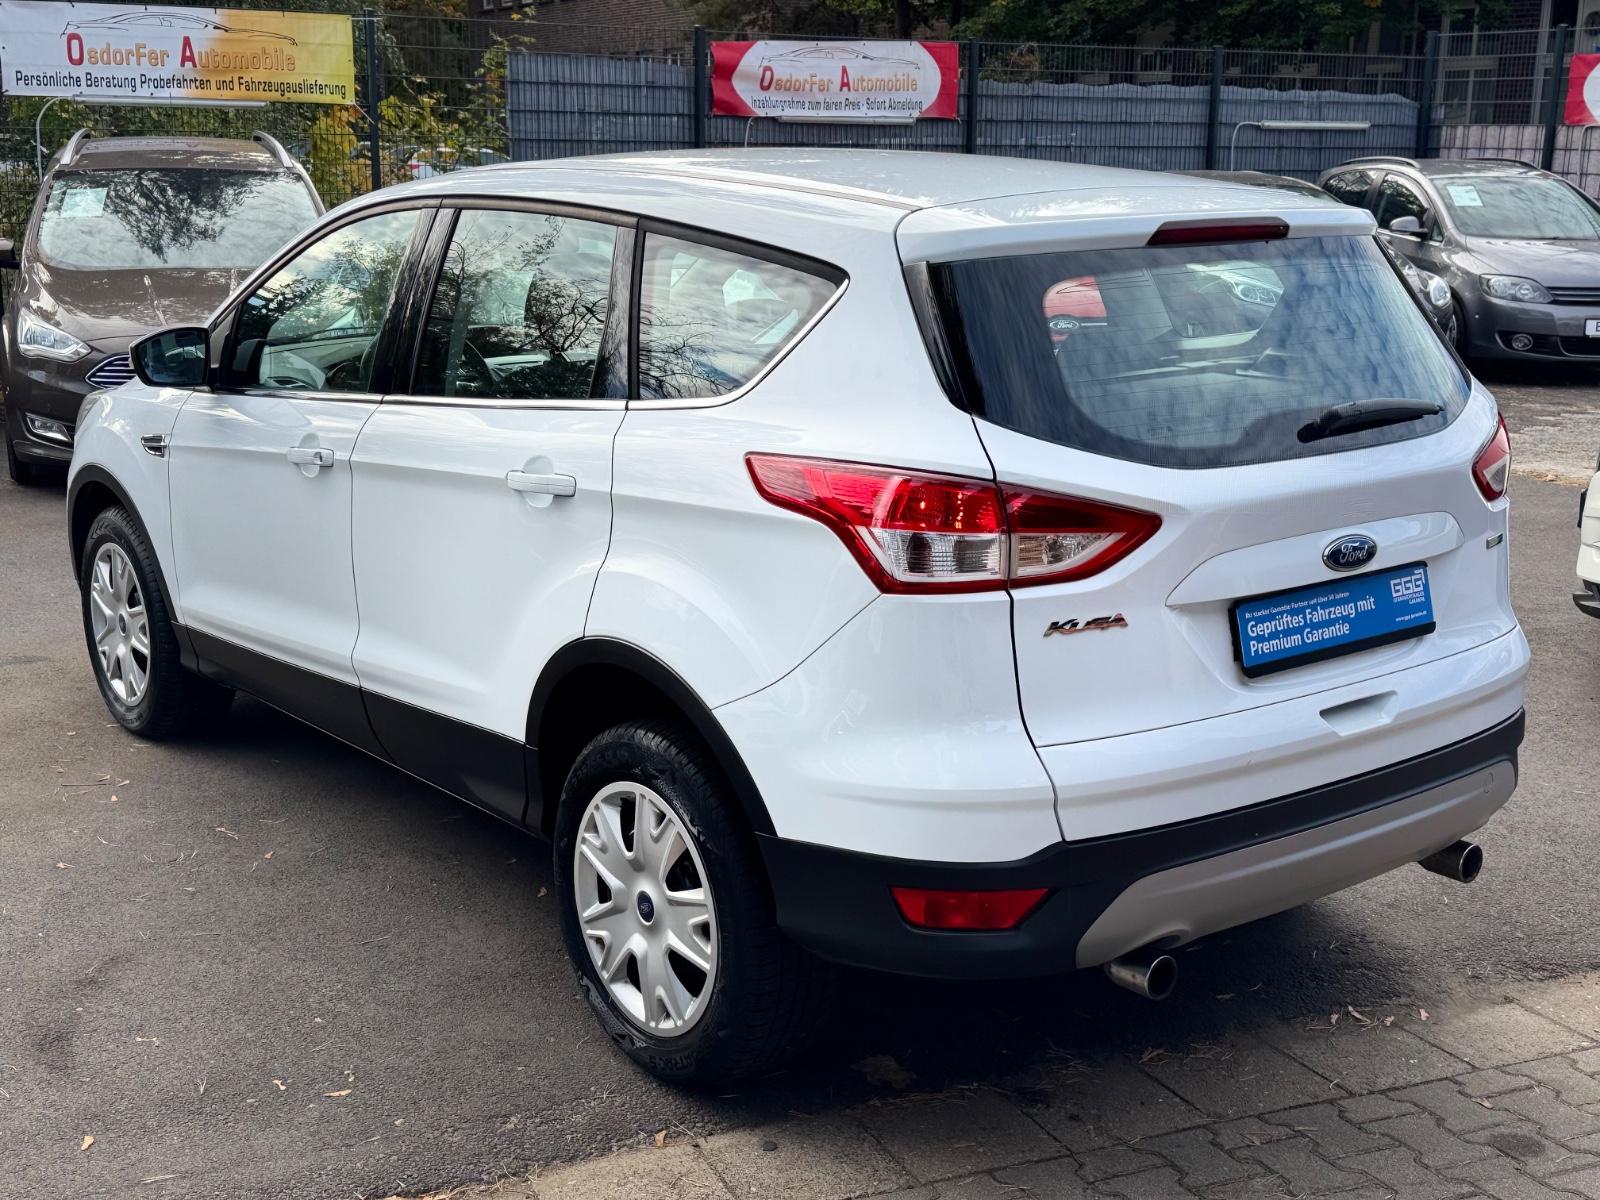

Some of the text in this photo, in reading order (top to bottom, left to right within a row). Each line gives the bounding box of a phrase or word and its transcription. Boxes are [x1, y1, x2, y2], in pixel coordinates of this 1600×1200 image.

[180, 35, 296, 71] Automobile
[15, 70, 347, 99] Persönliche Beratung Probefahrten und Fahrzeugauslieferung
[839, 64, 918, 92] Automobile
[807, 100, 821, 110] zum
[823, 98, 842, 110] fairen
[843, 97, 860, 110] Preis
[865, 97, 886, 110] Sofort
[887, 97, 923, 113] Abmeldung
[1340, 541, 1368, 563] Ford
[1043, 613, 1128, 637] KUGA
[1247, 612, 1304, 637] Geprüftes
[1305, 605, 1356, 624] Fahrzeug
[1357, 595, 1376, 612] mit
[1249, 620, 1350, 657] Premium Garantie
